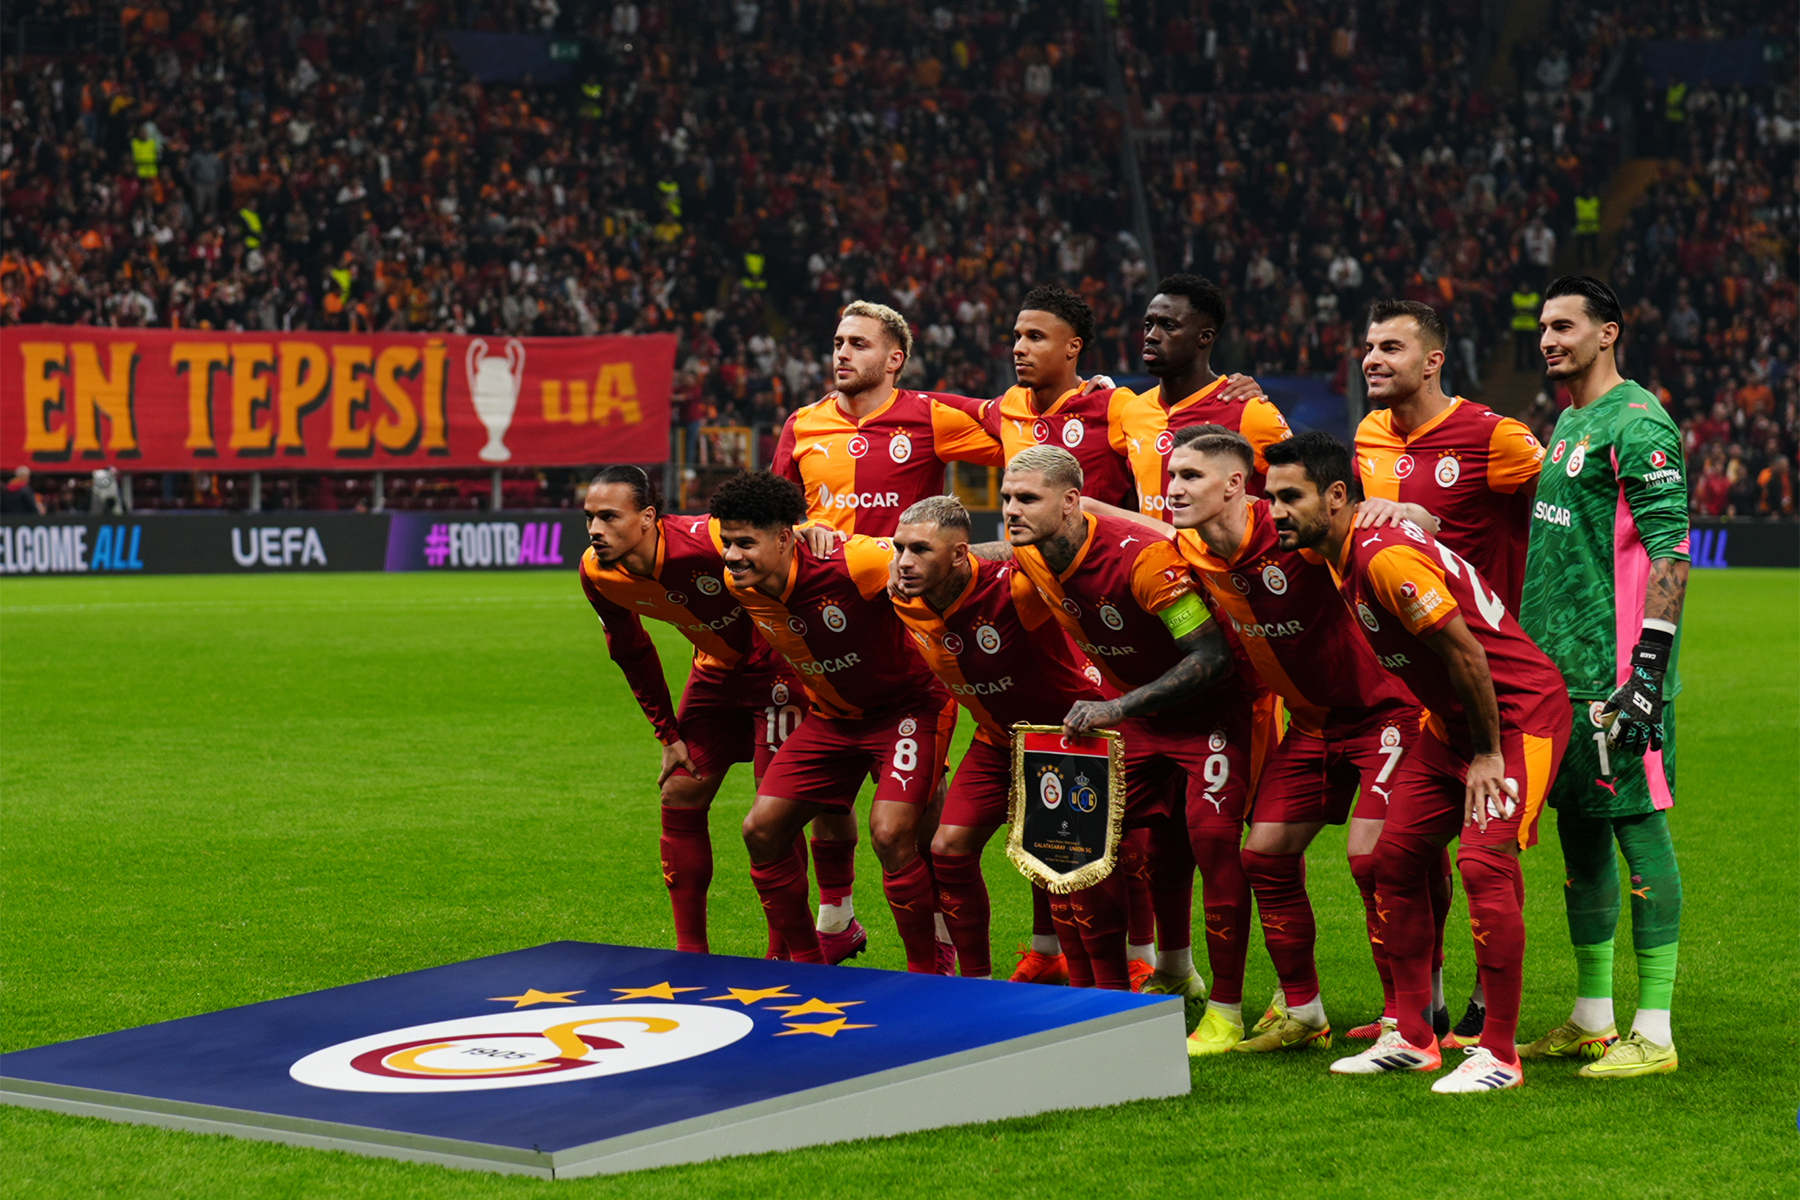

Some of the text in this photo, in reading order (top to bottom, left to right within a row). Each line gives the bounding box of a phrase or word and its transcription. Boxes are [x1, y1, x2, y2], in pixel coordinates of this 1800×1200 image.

[20, 342, 141, 460] EN
[835, 492, 899, 509] SOCAR
[91, 525, 143, 570] ALL
[231, 527, 327, 566] UEFA
[424, 522, 563, 567] #FOOTBALL
[1404, 587, 1438, 614] TURKISH
[1411, 595, 1443, 621] AIRLINES
[1243, 620, 1304, 638] SOCAR
[801, 652, 861, 675] SOCAR
[1076, 640, 1138, 656] SOCAR
[952, 676, 1015, 696] SOCAR
[765, 705, 801, 743] 10
[893, 738, 918, 771] 8
[1375, 746, 1403, 783] 7
[1593, 732, 1610, 775] 1
[1204, 754, 1228, 792] 9
[460, 1047, 536, 1060] 1905
